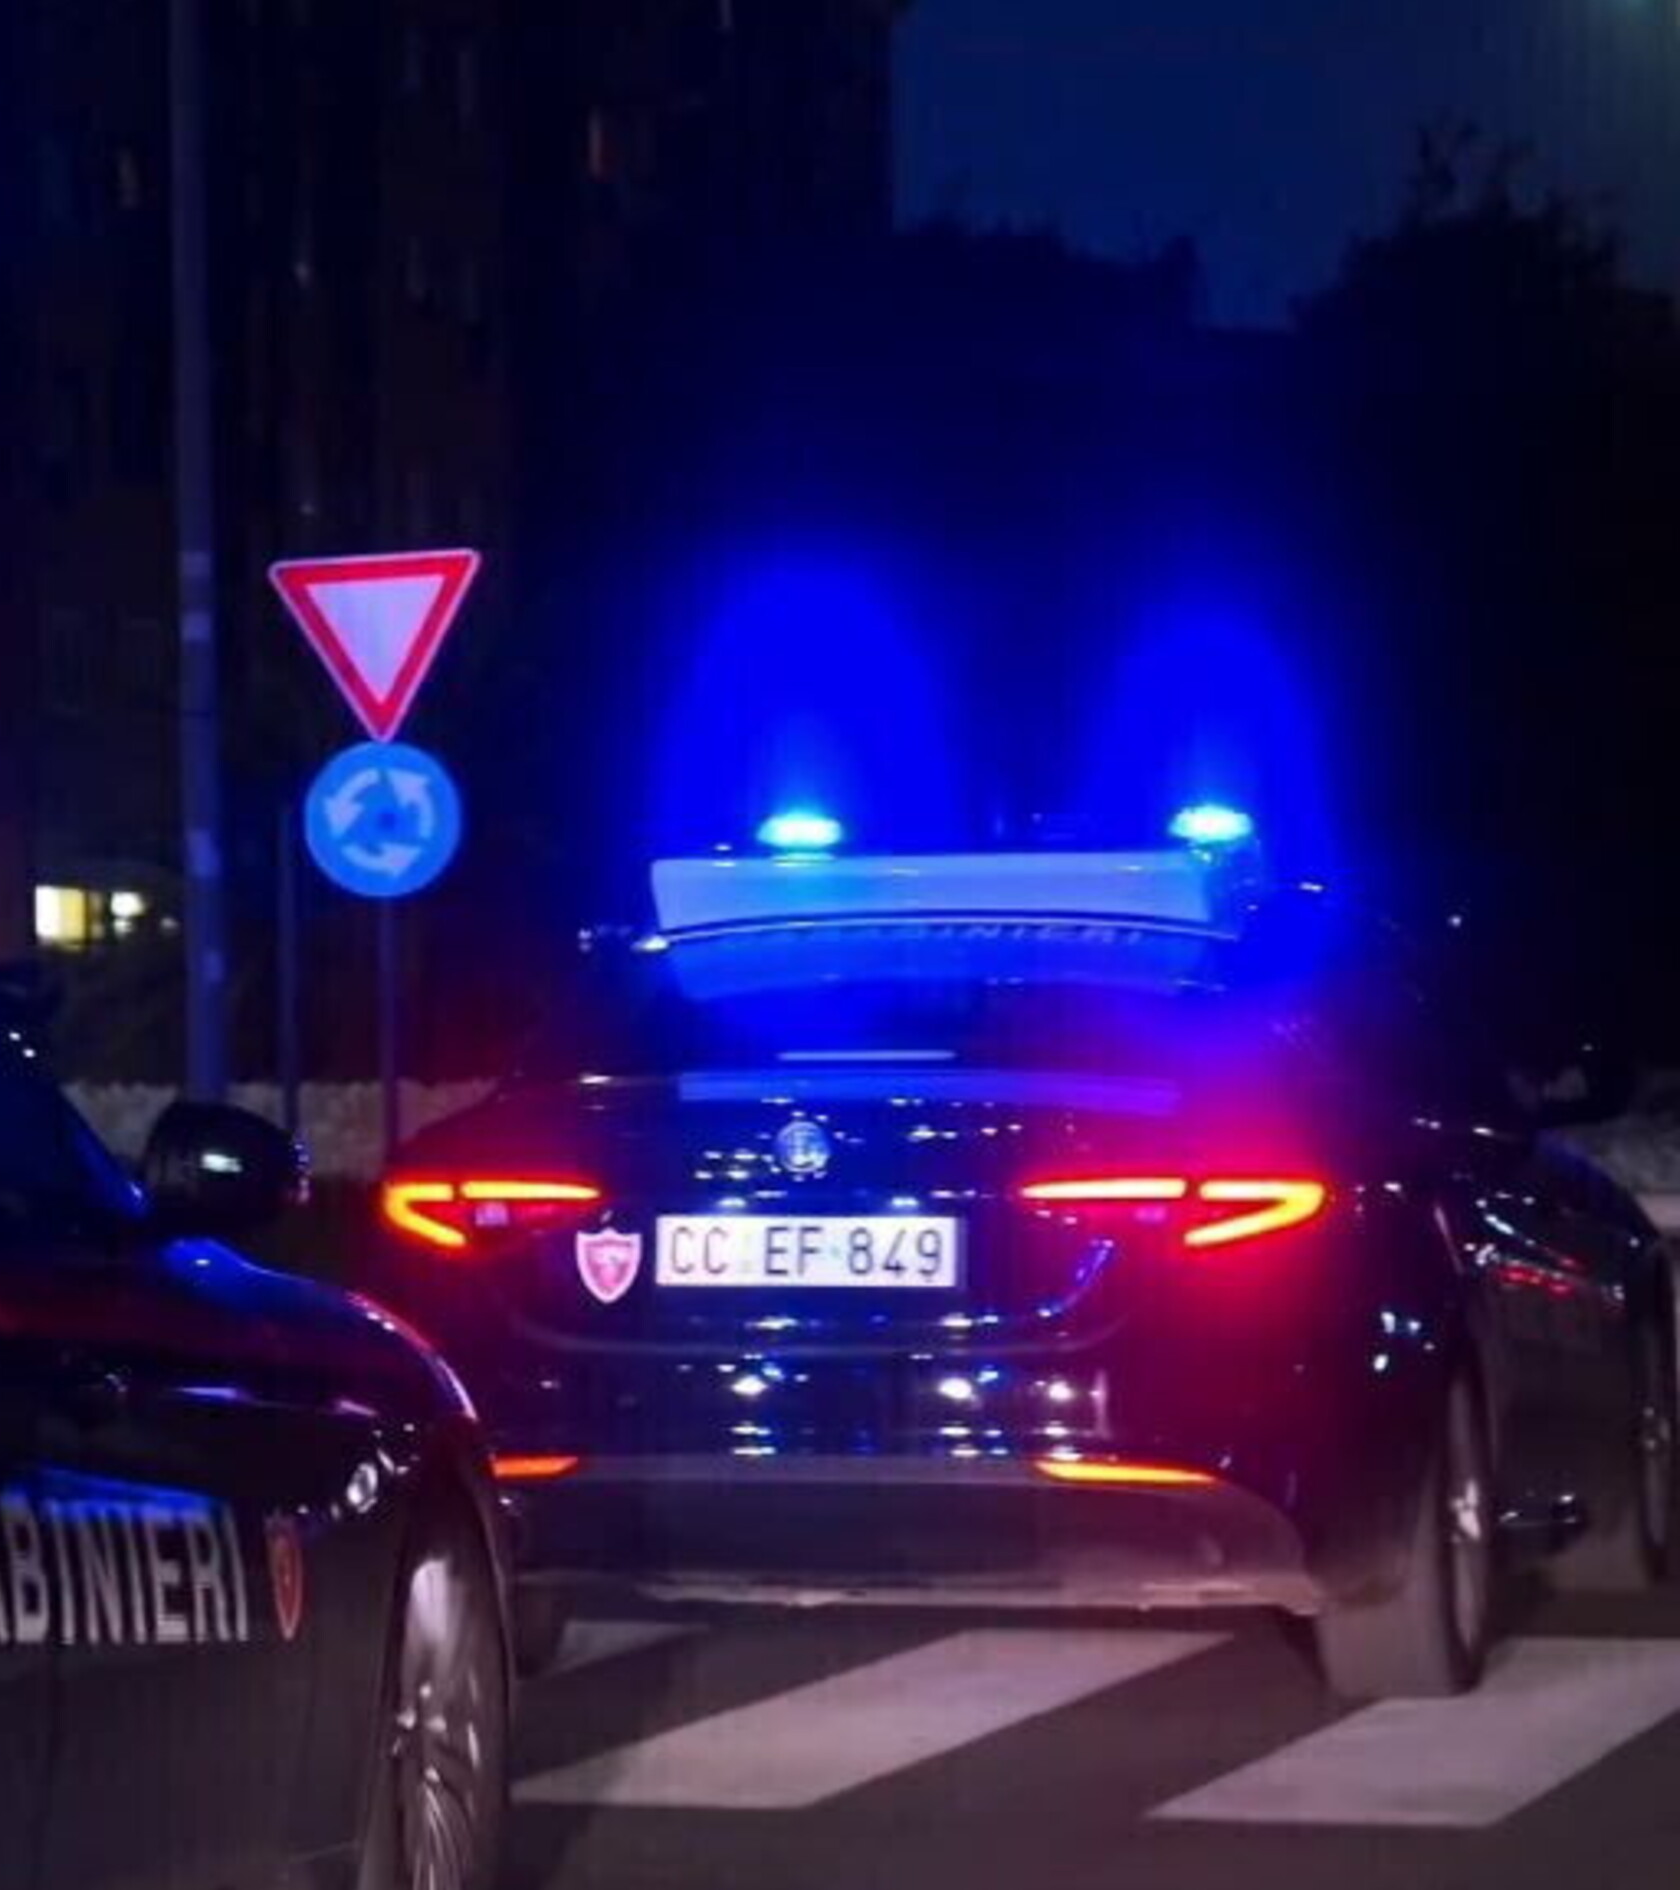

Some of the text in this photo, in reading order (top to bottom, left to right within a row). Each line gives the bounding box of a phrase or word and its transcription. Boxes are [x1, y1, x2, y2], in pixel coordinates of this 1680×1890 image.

[670, 1226, 943, 1277] CC EF 849
